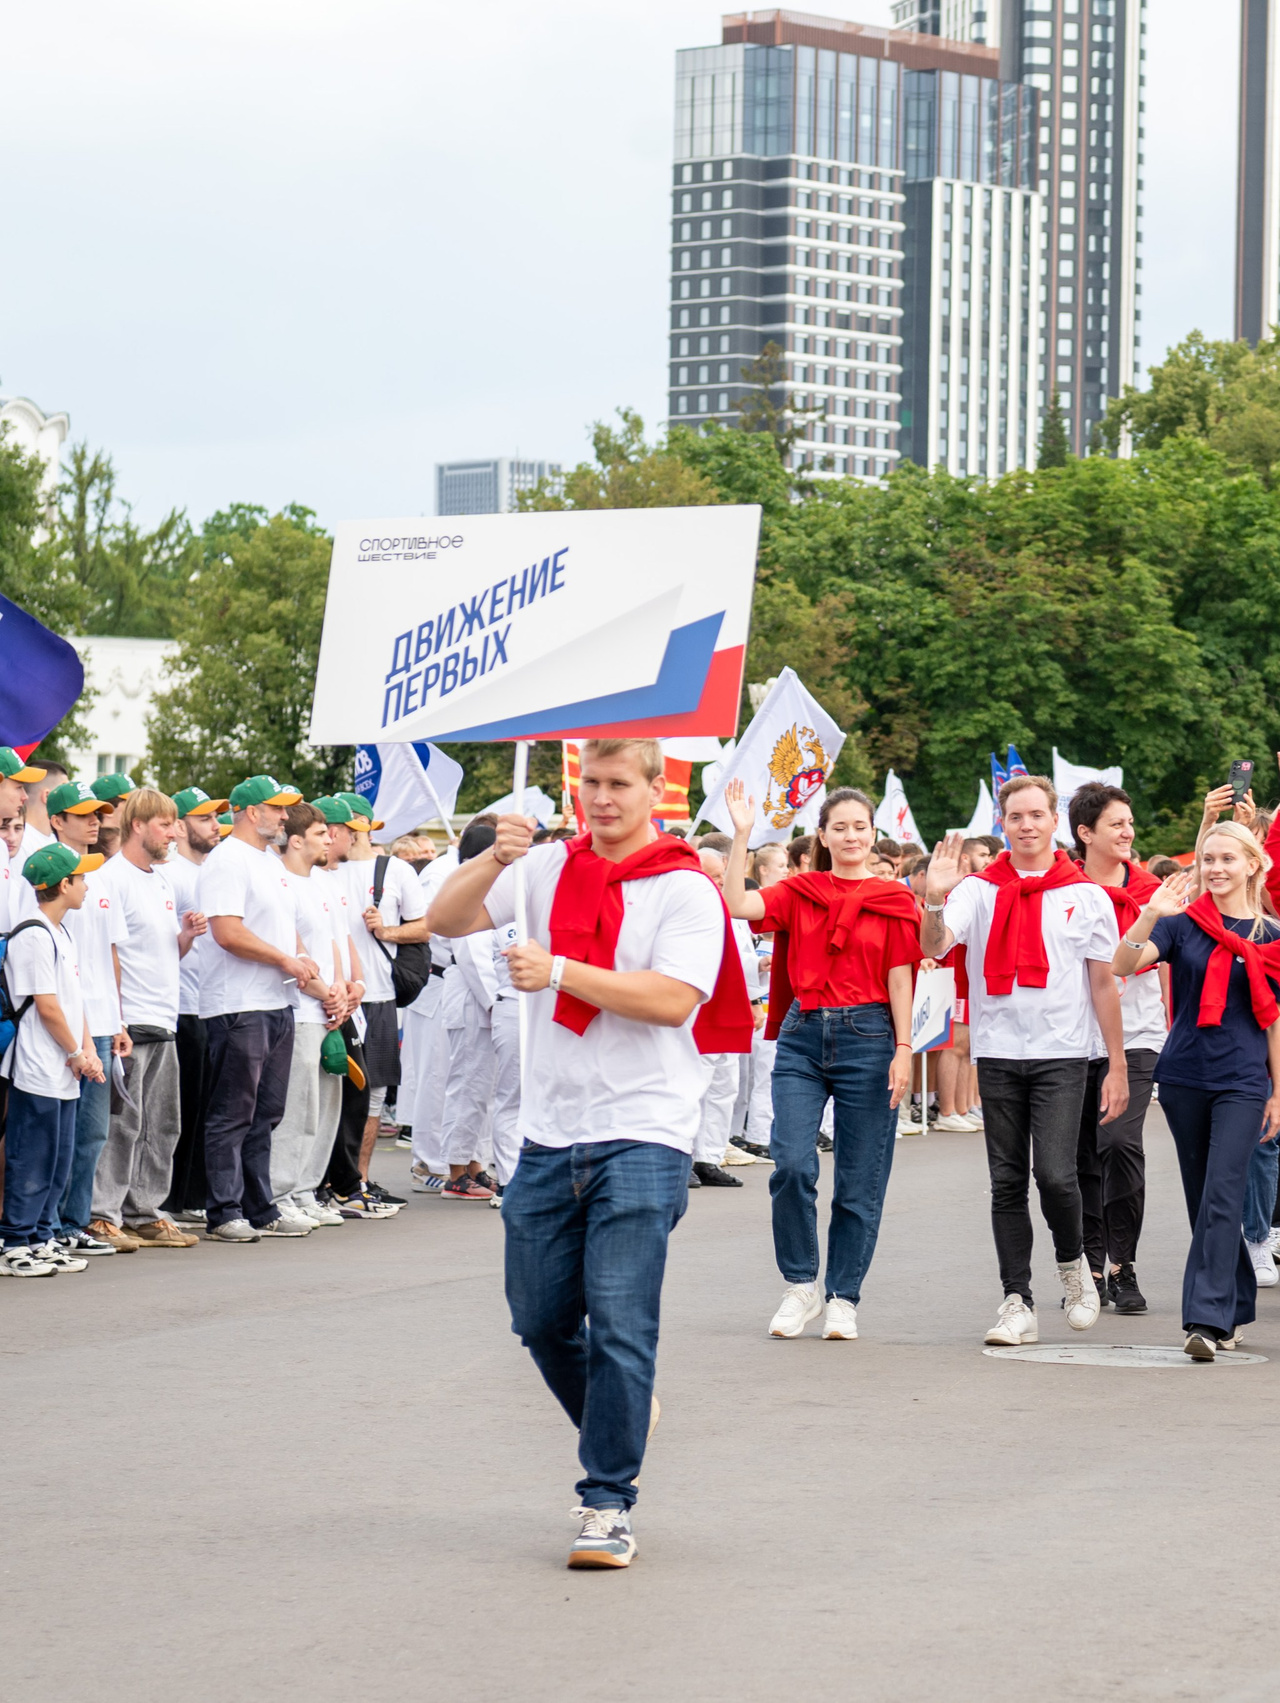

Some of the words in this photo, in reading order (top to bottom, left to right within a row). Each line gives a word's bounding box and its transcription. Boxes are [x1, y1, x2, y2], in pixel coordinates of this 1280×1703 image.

[357, 551, 437, 562] ШЕСТВИЕ
[385, 547, 569, 684] ДВИЖЕНИЕ
[381, 622, 512, 729] ПЕРВЫХ
